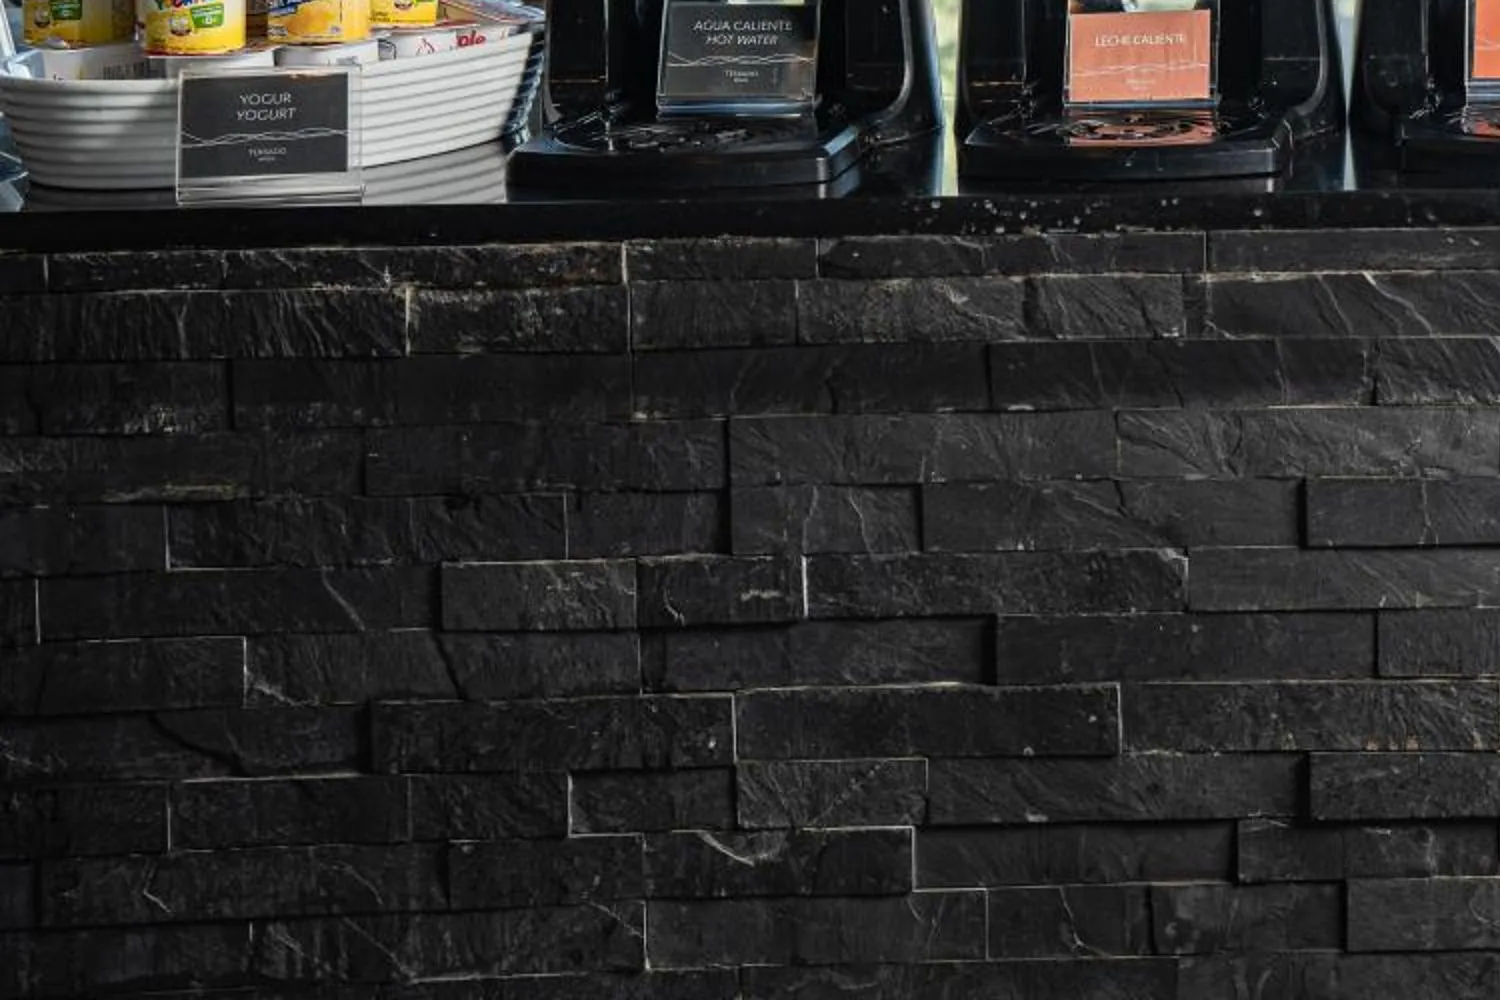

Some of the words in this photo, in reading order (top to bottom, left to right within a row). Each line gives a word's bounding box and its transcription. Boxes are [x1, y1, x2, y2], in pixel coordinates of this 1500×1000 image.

[692, 19, 732, 31] AGUA
[733, 19, 793, 32] CALIENTE
[705, 34, 733, 45] HOT
[736, 34, 779, 46] WATER
[239, 92, 292, 105] YOGUR
[236, 106, 297, 121] YOGURT
